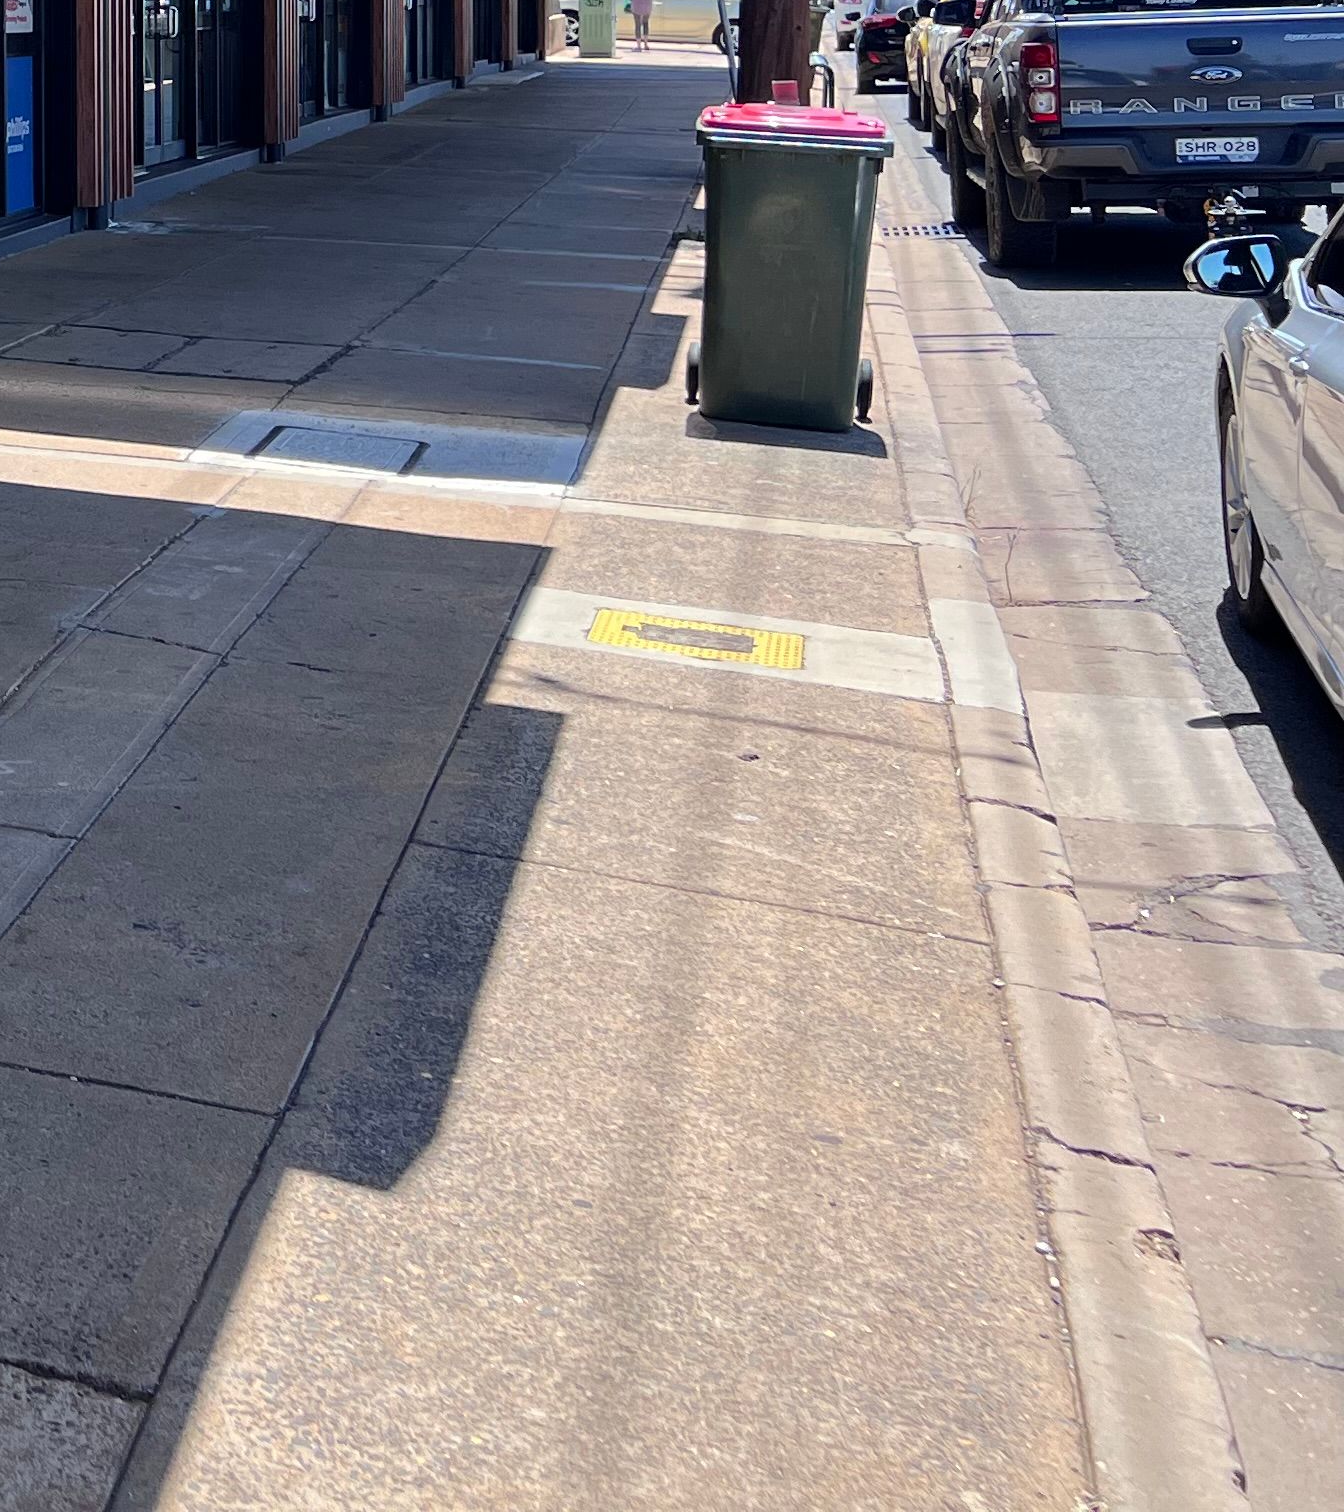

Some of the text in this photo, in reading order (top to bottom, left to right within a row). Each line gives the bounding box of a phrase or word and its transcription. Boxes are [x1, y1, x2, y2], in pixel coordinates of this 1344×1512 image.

[1205, 70, 1228, 80] Ford
[1184, 141, 1217, 153] SHR
[1223, 140, 1257, 152] 028
